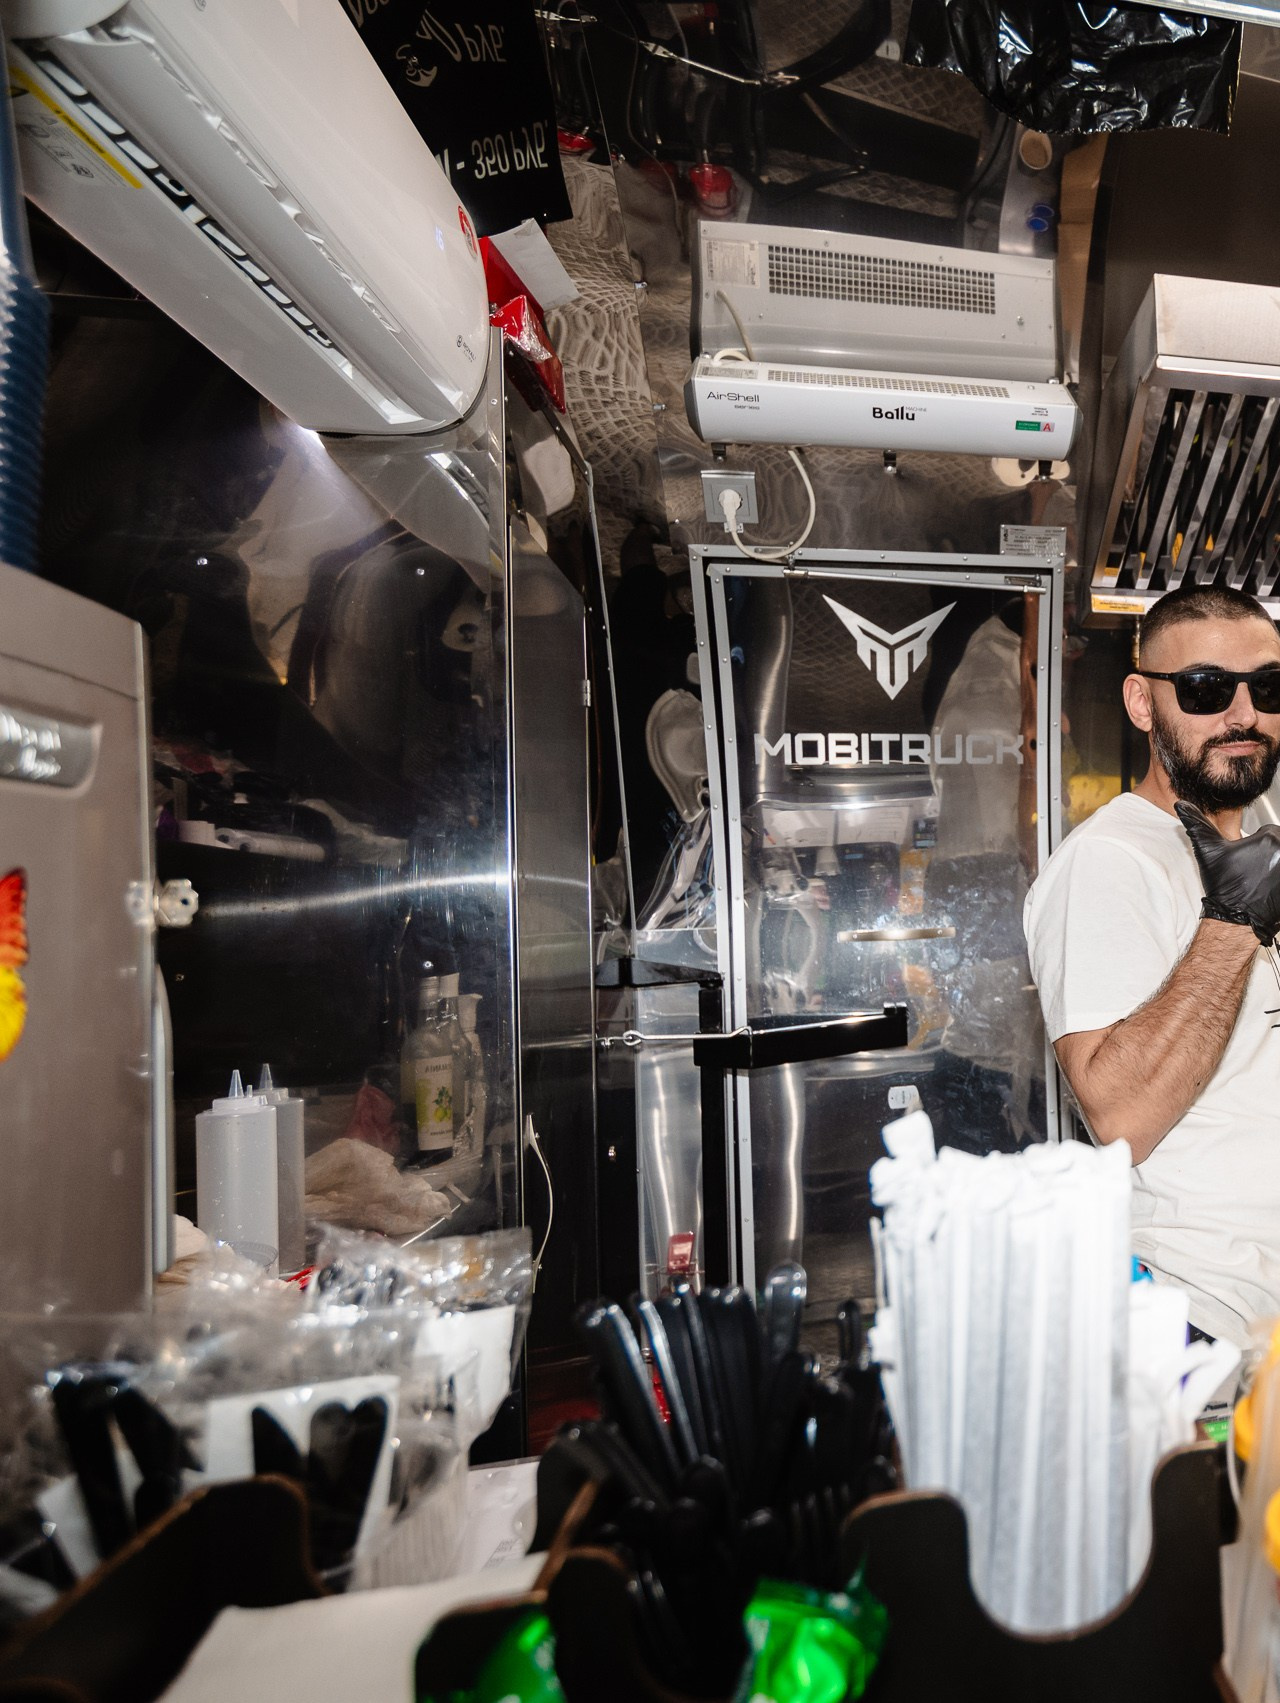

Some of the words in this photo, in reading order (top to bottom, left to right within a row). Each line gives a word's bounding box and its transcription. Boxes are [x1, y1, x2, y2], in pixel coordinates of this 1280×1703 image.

[706, 391, 760, 403] AirShell
[872, 406, 915, 421] Ballu
[753, 732, 1025, 766] MOBITRUCK
